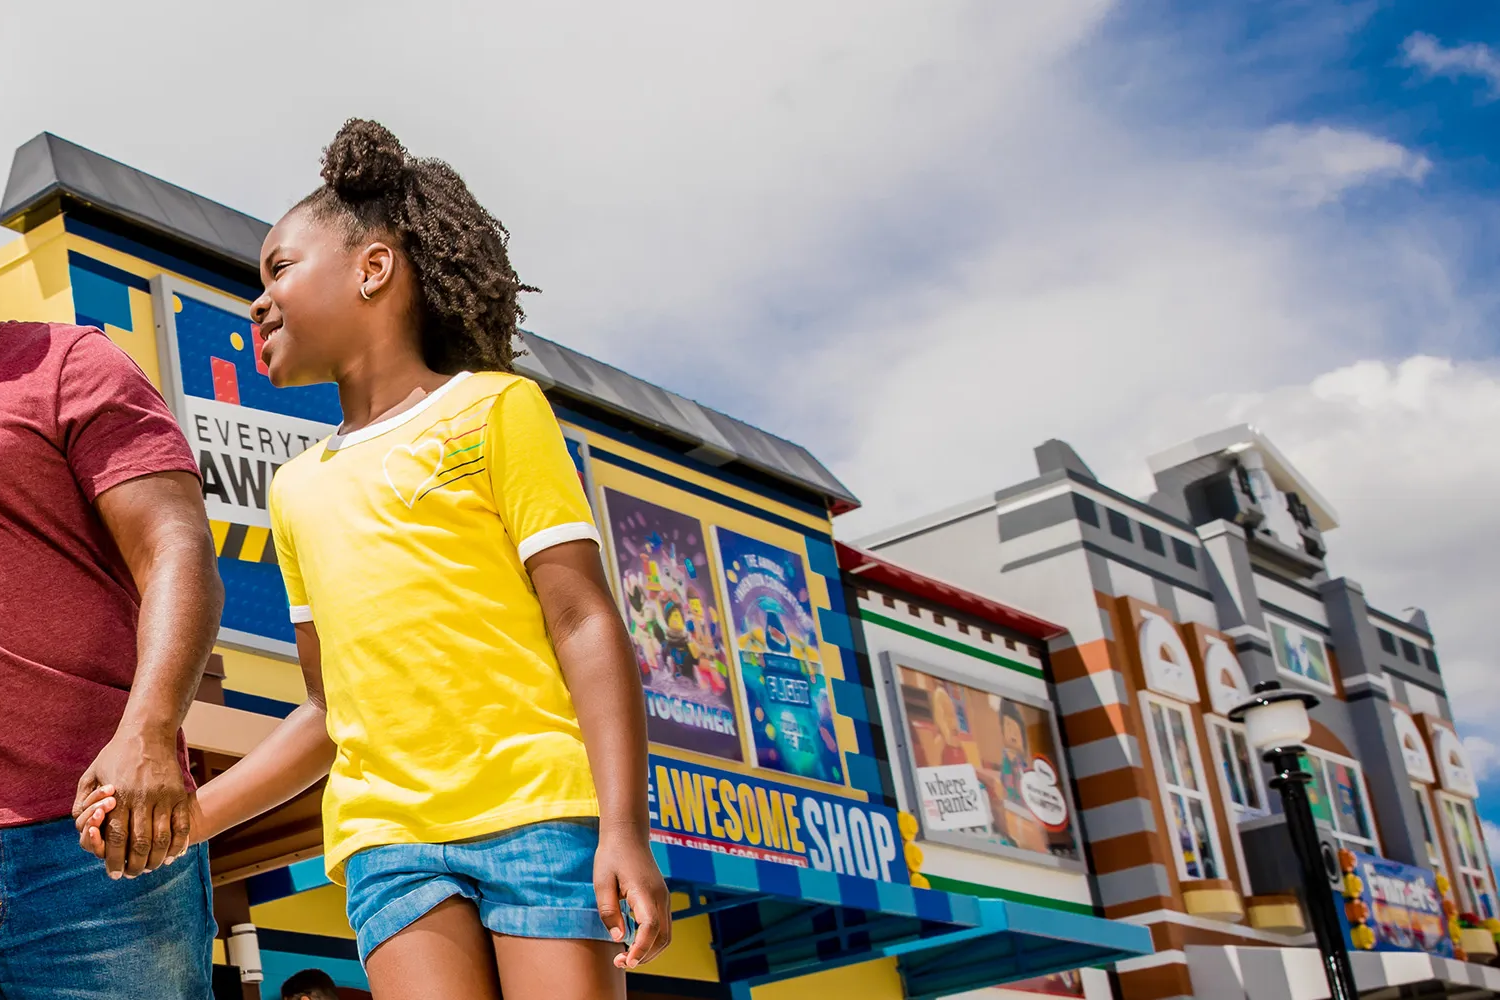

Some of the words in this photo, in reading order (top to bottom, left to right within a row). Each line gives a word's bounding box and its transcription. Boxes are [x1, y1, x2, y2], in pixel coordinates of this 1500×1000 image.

[200, 449, 283, 510] AW
[644, 689, 736, 736] TOGETHER
[925, 773, 967, 797] where
[936, 789, 978, 821] pants?
[655, 765, 806, 853] AWESOME
[802, 797, 896, 882] SHOP
